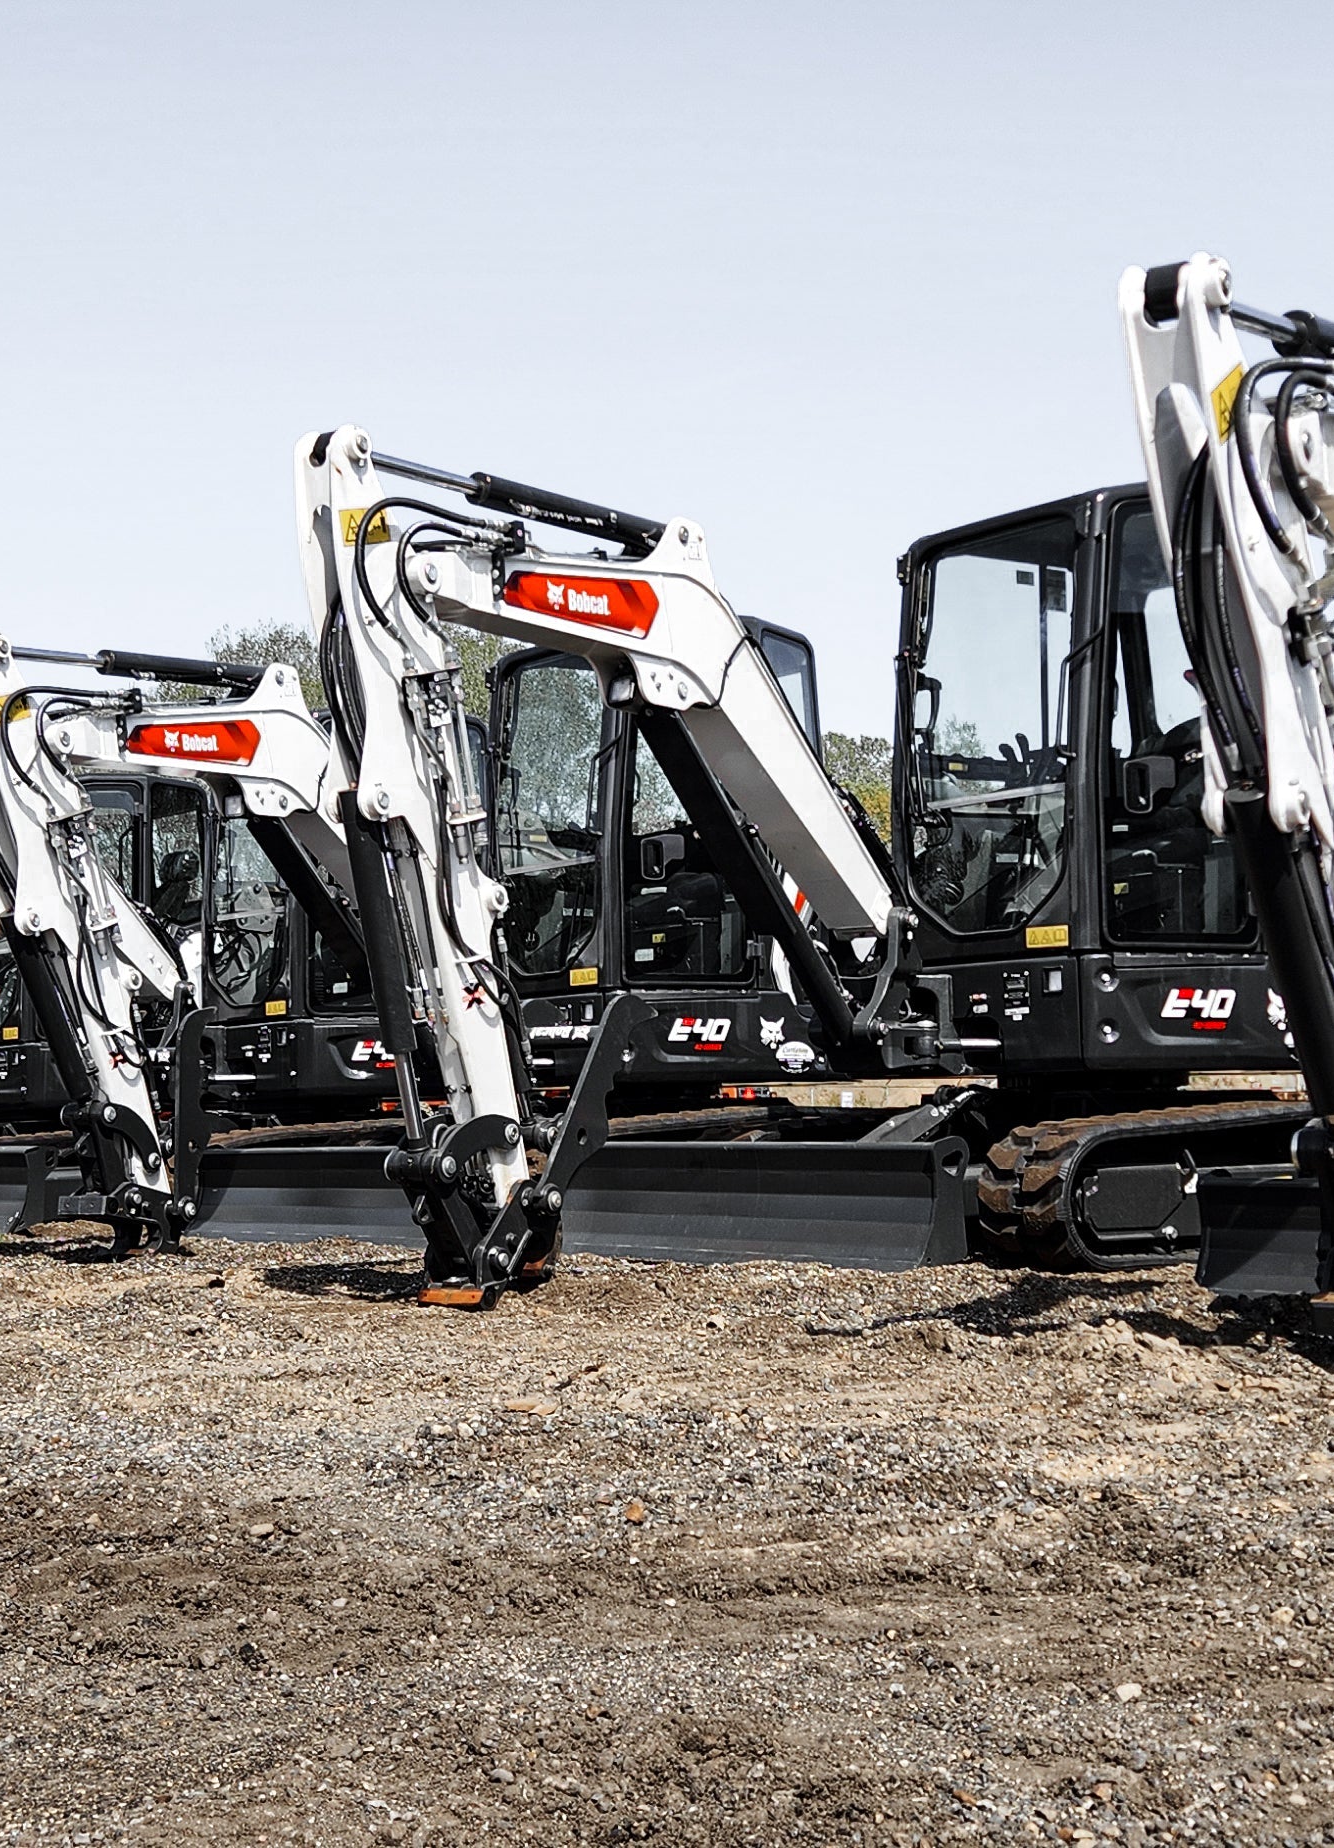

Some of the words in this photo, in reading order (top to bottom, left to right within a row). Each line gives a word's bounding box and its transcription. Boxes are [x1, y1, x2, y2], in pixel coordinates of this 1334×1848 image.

[567, 588, 610, 616] Bobcat
[181, 733, 218, 751] Bobcat
[1160, 988, 1236, 1018] E40
[667, 1017, 731, 1041] E40
